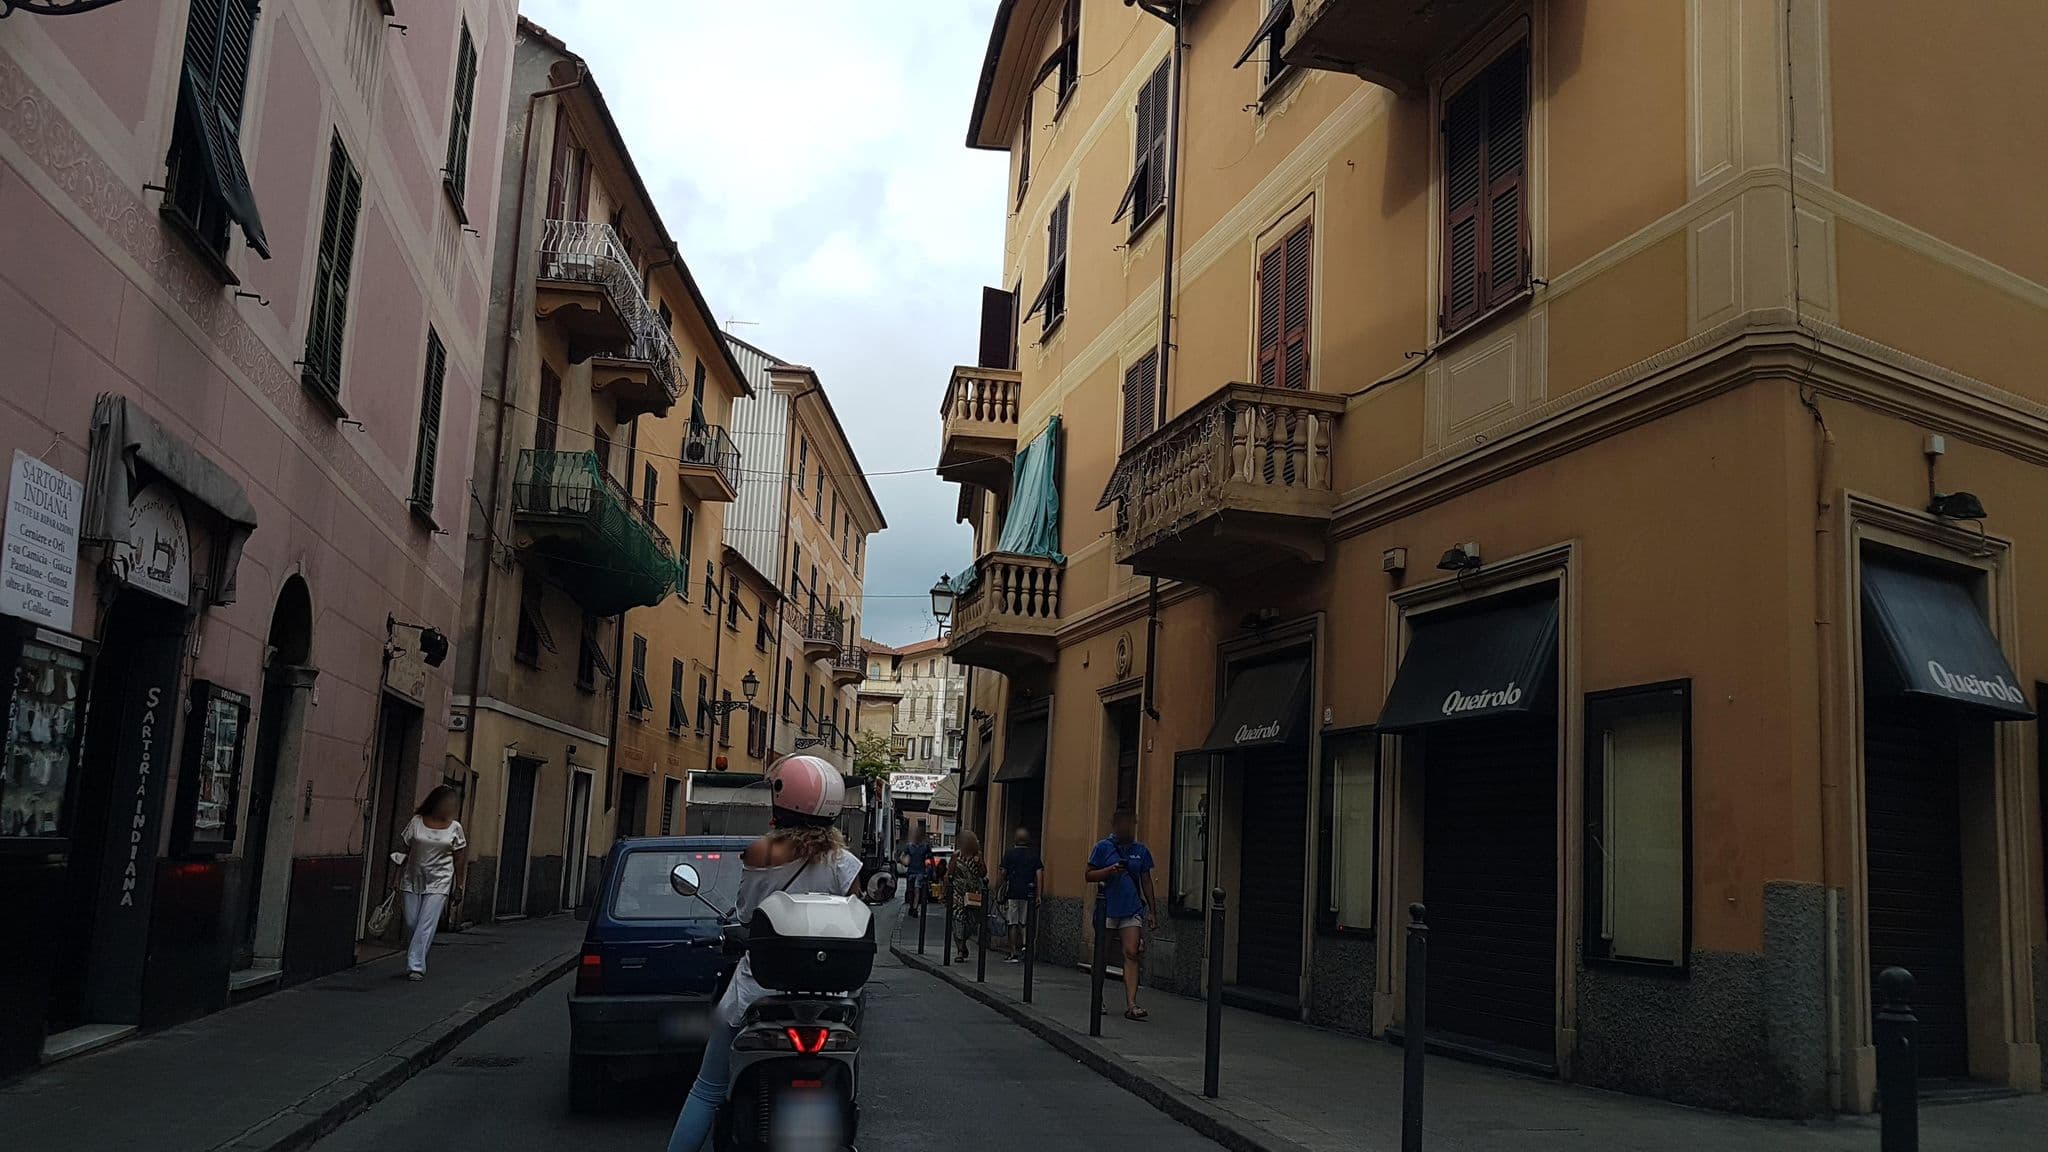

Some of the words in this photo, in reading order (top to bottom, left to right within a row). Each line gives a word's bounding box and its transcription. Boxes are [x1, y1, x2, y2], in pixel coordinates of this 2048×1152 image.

[24, 460, 73, 502] SARTORIA
[24, 482, 69, 520] INDIANA
[14, 501, 33, 519] TUTTE
[40, 513, 74, 538] RIPARAZIONI
[20, 523, 47, 545] Cerniere
[52, 537, 65, 553] Orli
[22, 545, 48, 566] Camicia
[10, 557, 43, 580] Pantalone
[47, 571, 68, 589] Gonna
[26, 581, 44, 599] Borse
[27, 598, 52, 618] Collane
[1441, 681, 1522, 716] Queirolo
[1928, 659, 2025, 704] Queirolo
[136, 687, 162, 795] SARTORIA
[1233, 719, 1282, 744] Queirolo
[120, 799, 146, 907] INDIANA
